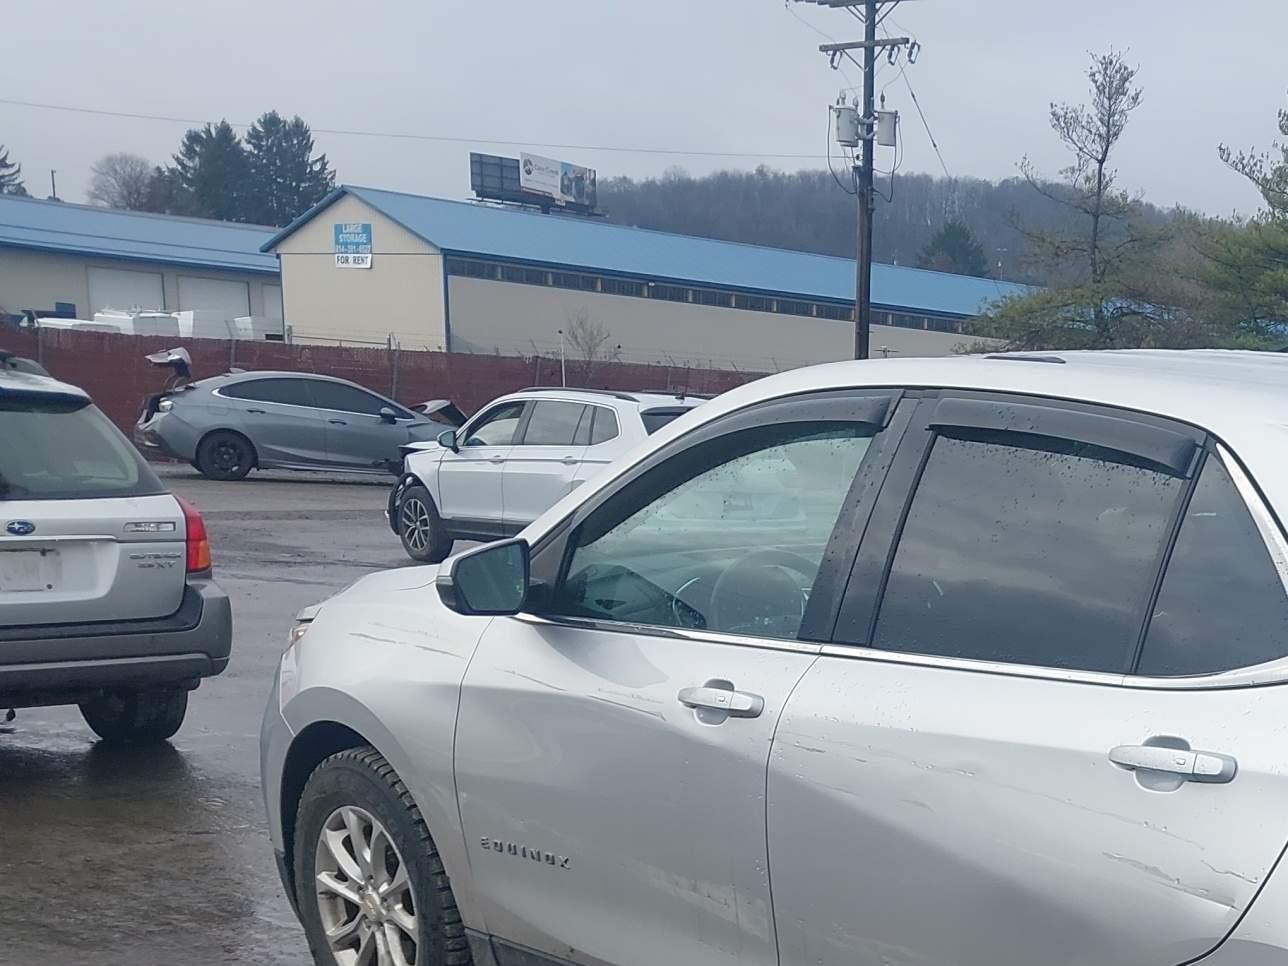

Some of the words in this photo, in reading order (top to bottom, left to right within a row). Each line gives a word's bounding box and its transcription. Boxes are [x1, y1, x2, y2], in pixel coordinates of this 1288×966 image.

[339, 234, 367, 243] STORAGE
[336, 255, 350, 265] FOR
[352, 255, 369, 265] RENT
[479, 835, 572, 871] EQUINOX
